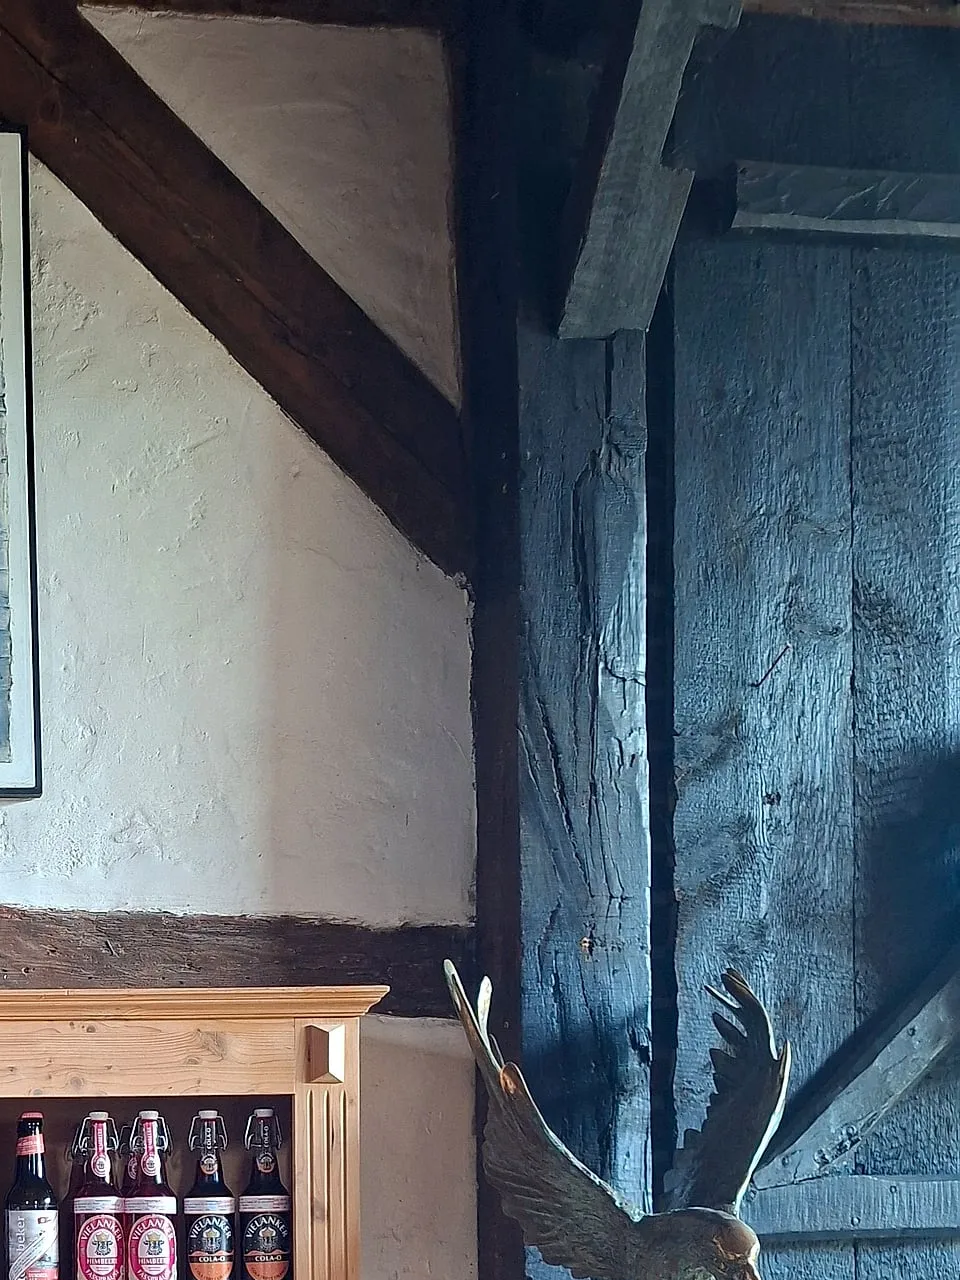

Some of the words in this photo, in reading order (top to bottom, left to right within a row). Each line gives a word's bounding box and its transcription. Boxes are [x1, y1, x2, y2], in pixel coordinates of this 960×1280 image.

[81, 1218, 122, 1241] VIELANKER
[190, 1216, 232, 1239] VIELANKER
[245, 1215, 289, 1238] VIELANKER
[199, 1255, 226, 1263] COLA-O
[254, 1254, 282, 1262] COLA-O
